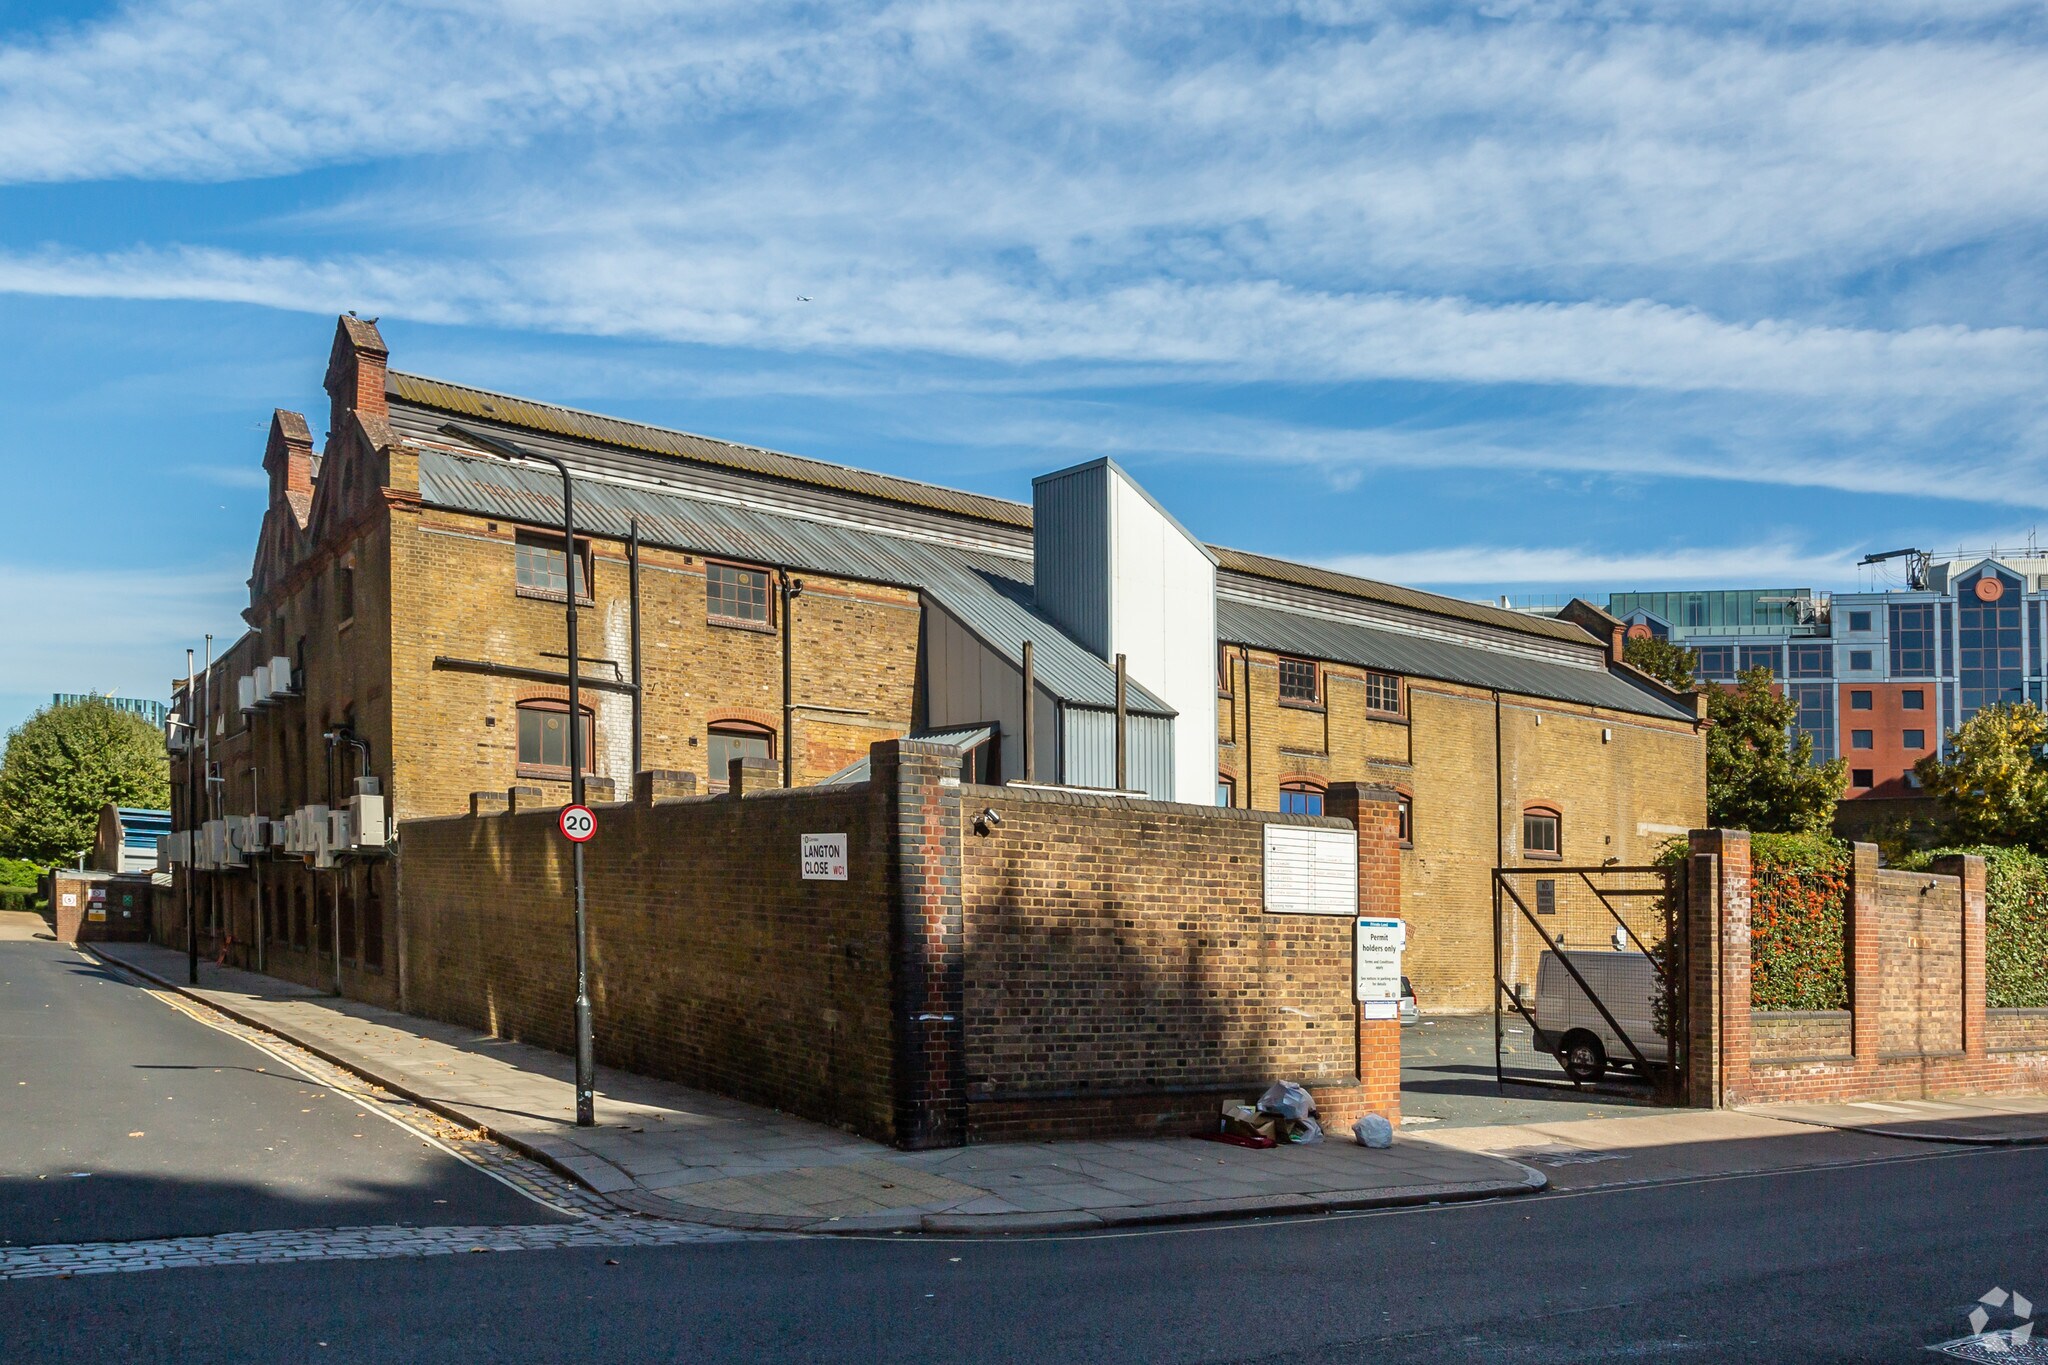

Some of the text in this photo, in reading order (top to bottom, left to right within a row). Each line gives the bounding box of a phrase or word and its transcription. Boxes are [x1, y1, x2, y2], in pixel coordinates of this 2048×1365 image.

[566, 816, 591, 831] 20
[804, 845, 840, 858] LANGTON
[804, 861, 845, 875] CLOSE WC1
[1362, 944, 1396, 954] holders only
